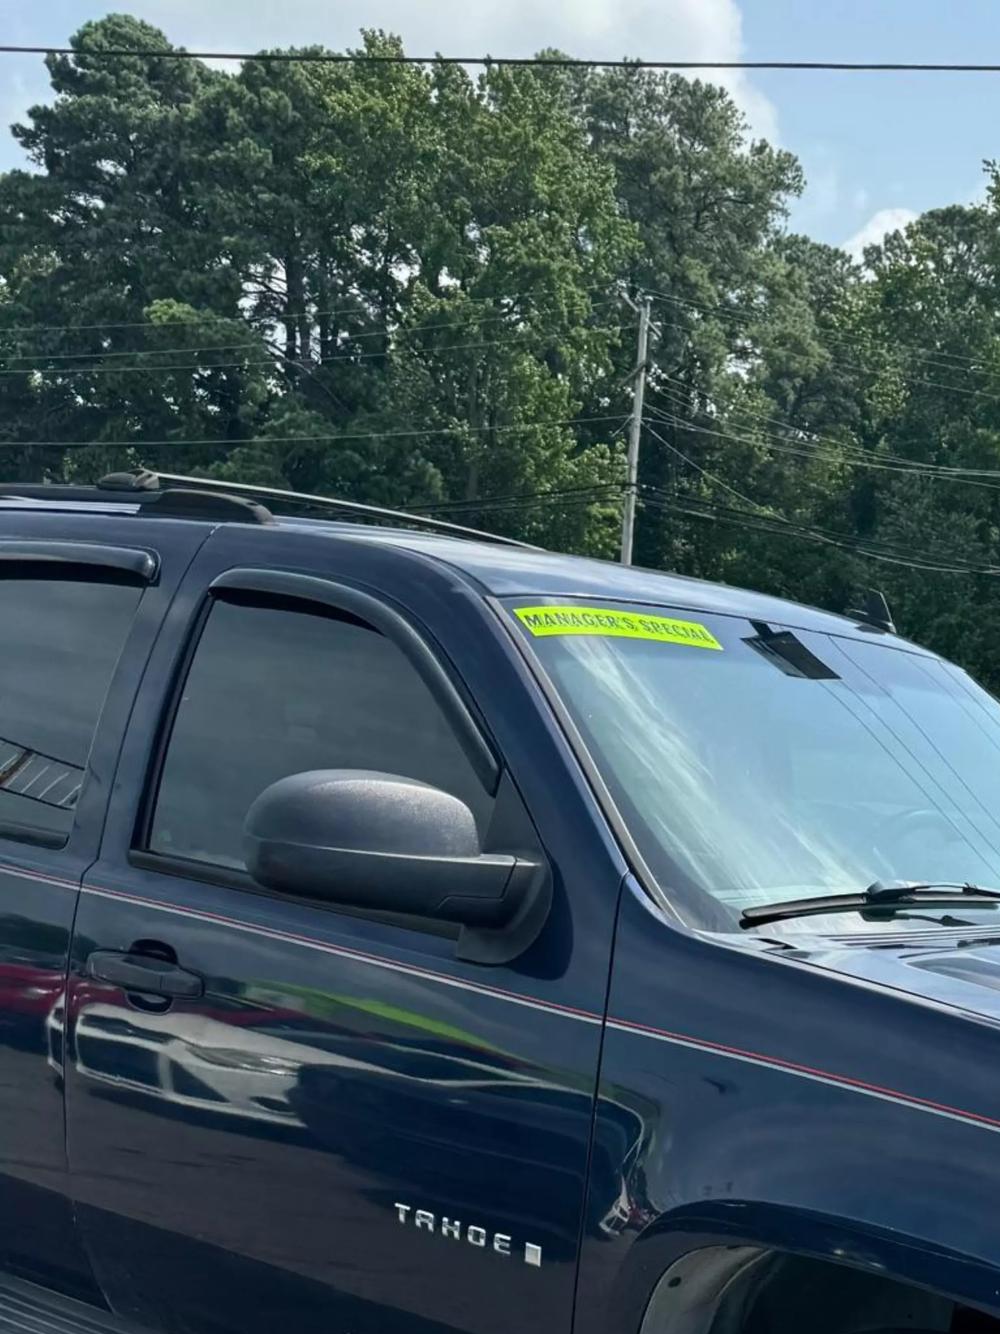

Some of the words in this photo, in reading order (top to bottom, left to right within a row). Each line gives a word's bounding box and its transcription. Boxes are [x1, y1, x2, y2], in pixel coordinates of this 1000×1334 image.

[523, 611, 635, 630] MANAGER'S
[638, 618, 715, 643] SPECIAL
[394, 1202, 512, 1255] TAHOE
